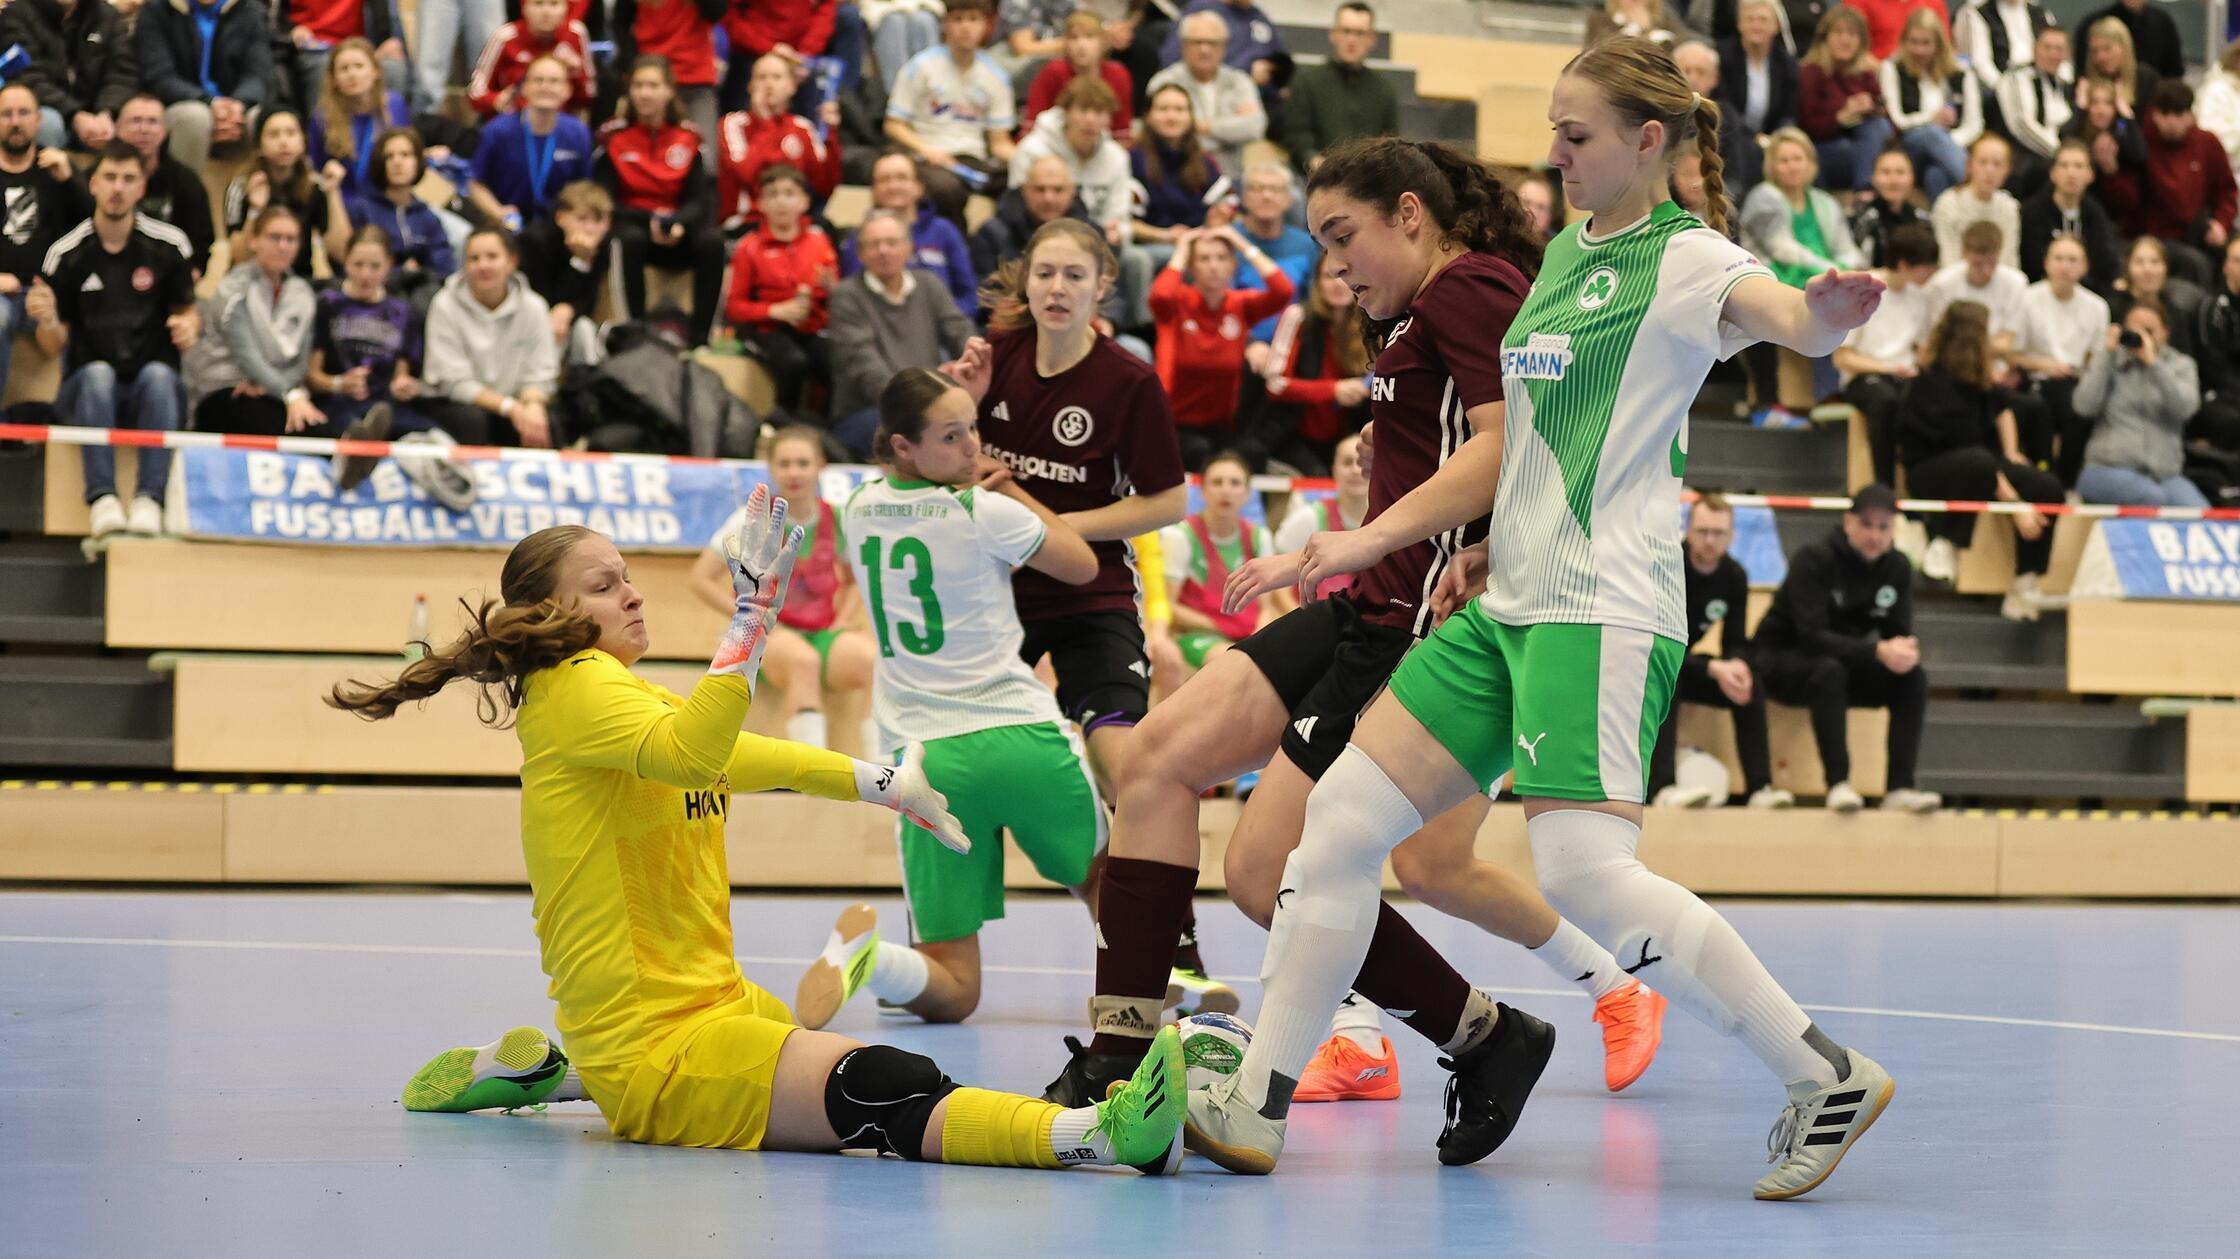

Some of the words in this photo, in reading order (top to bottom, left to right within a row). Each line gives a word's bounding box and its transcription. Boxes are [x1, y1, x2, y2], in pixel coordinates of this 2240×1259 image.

[1502, 351, 1562, 377] FMANN
[1371, 376, 1396, 402] EN
[246, 451, 676, 504] BAESCHER
[915, 501, 949, 519] FÜRTH
[860, 536, 945, 658] 13
